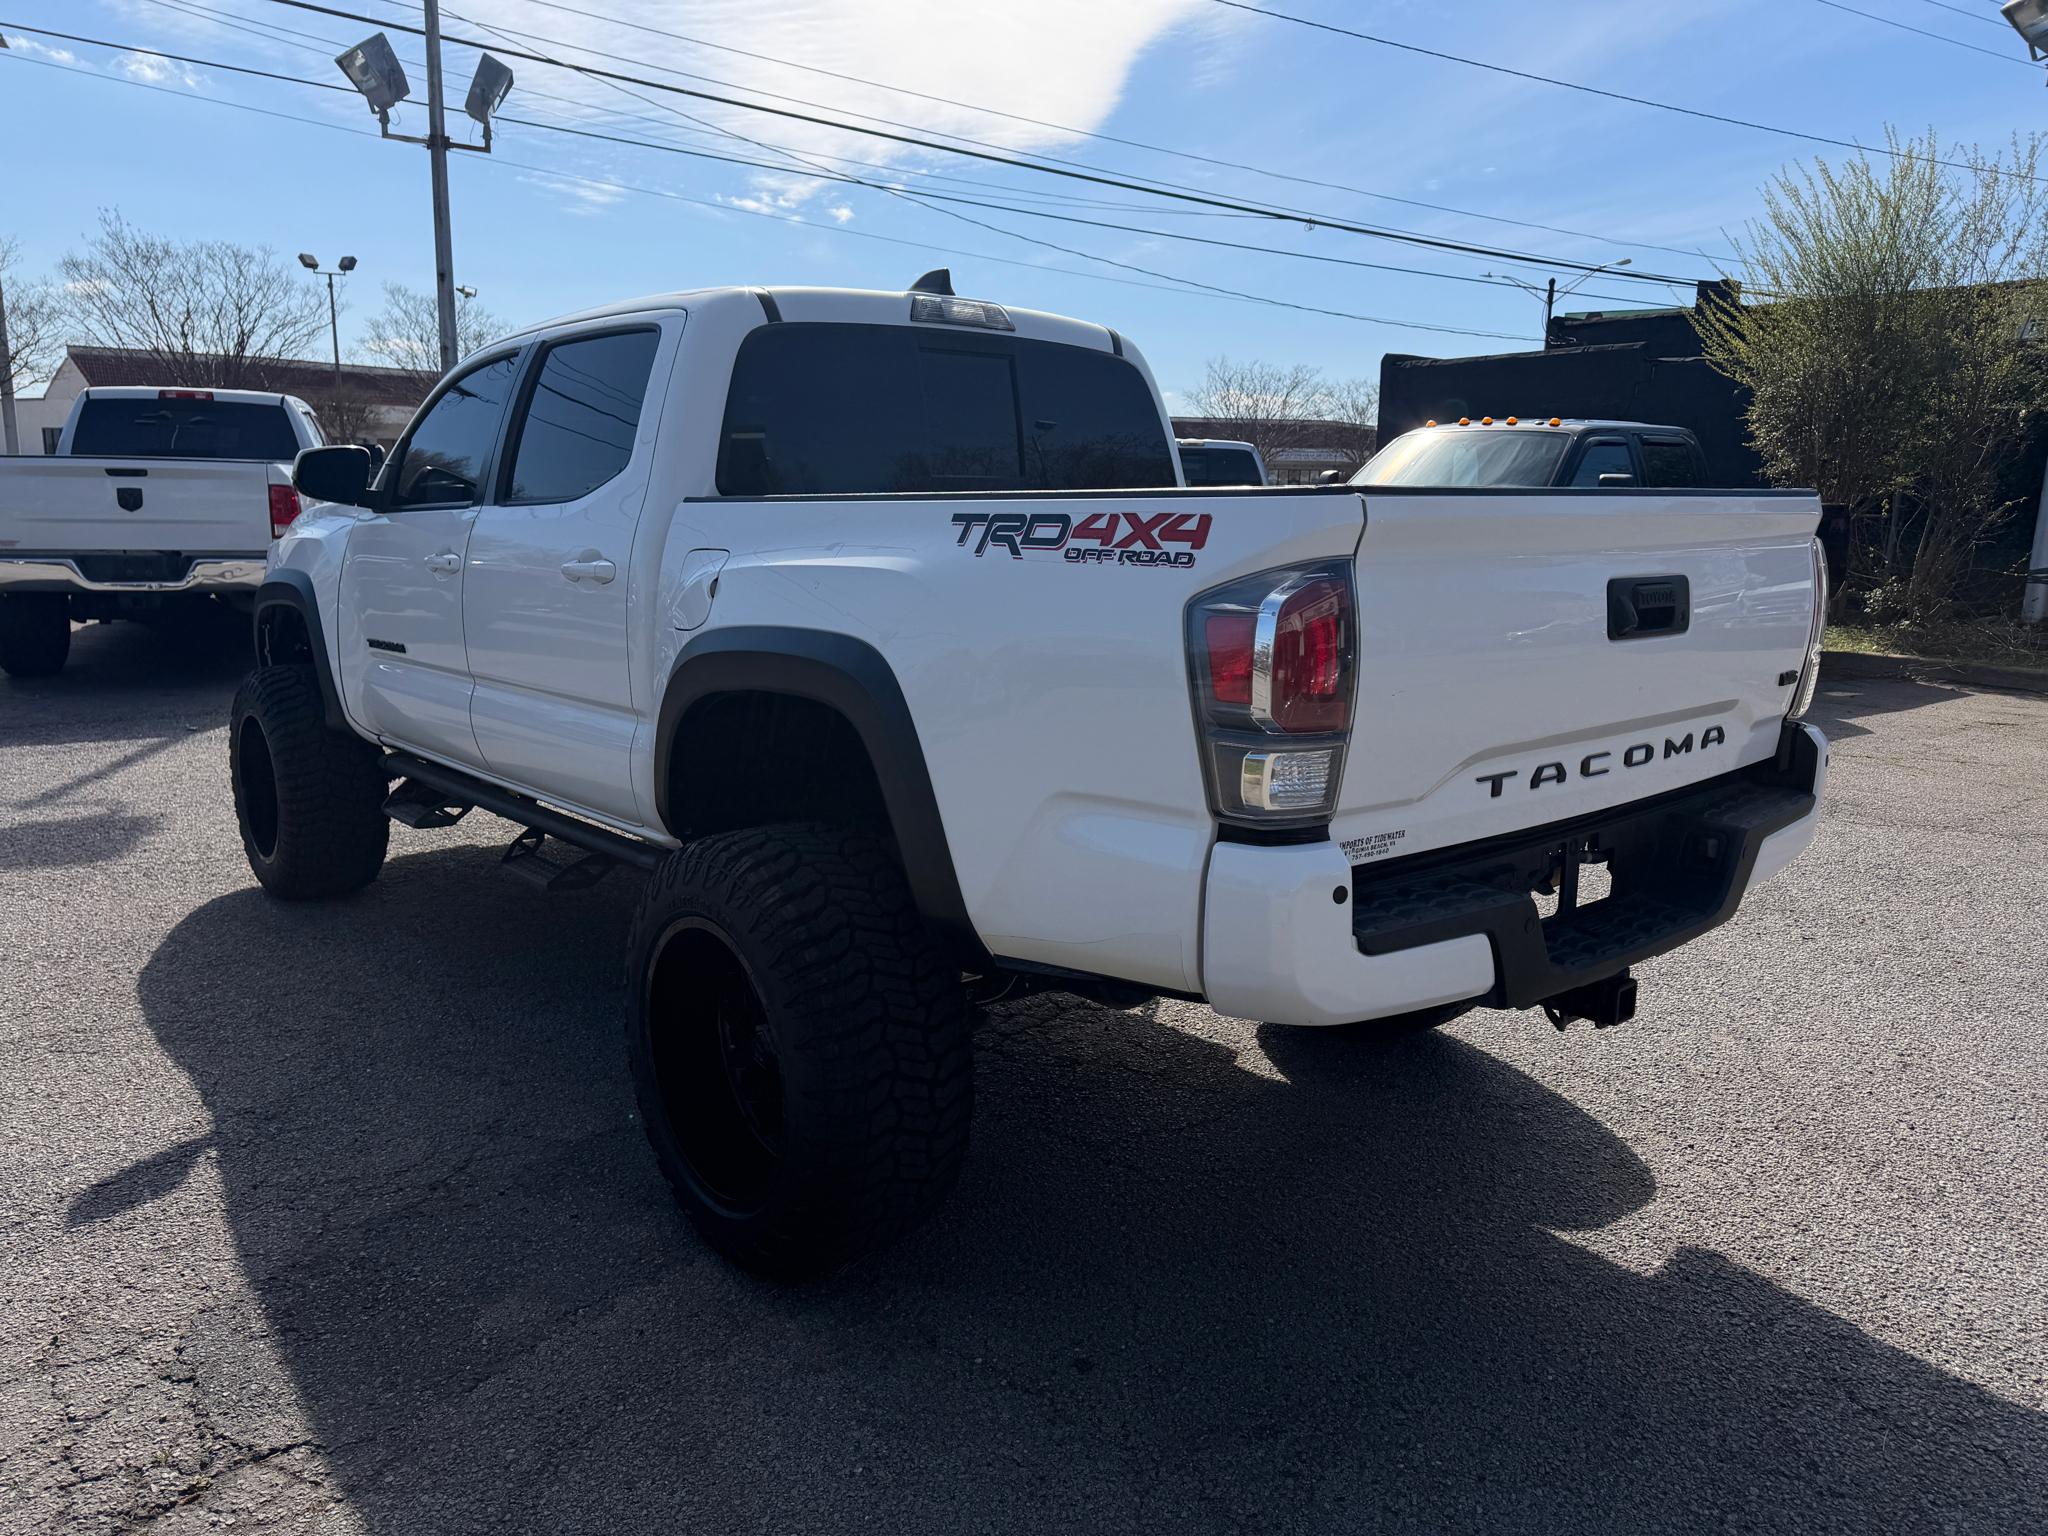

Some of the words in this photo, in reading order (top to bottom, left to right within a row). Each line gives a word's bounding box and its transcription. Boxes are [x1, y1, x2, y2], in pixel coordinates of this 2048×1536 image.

[952, 513, 1073, 560] TRD
[1064, 547, 1117, 565] OFF
[1117, 549, 1196, 568] ROAD
[1475, 725, 1726, 798] TACOMA
[1339, 838, 1364, 849] IMPORTS
[1365, 836, 1373, 845] OF
[1374, 830, 1406, 843] TIDEWATER
